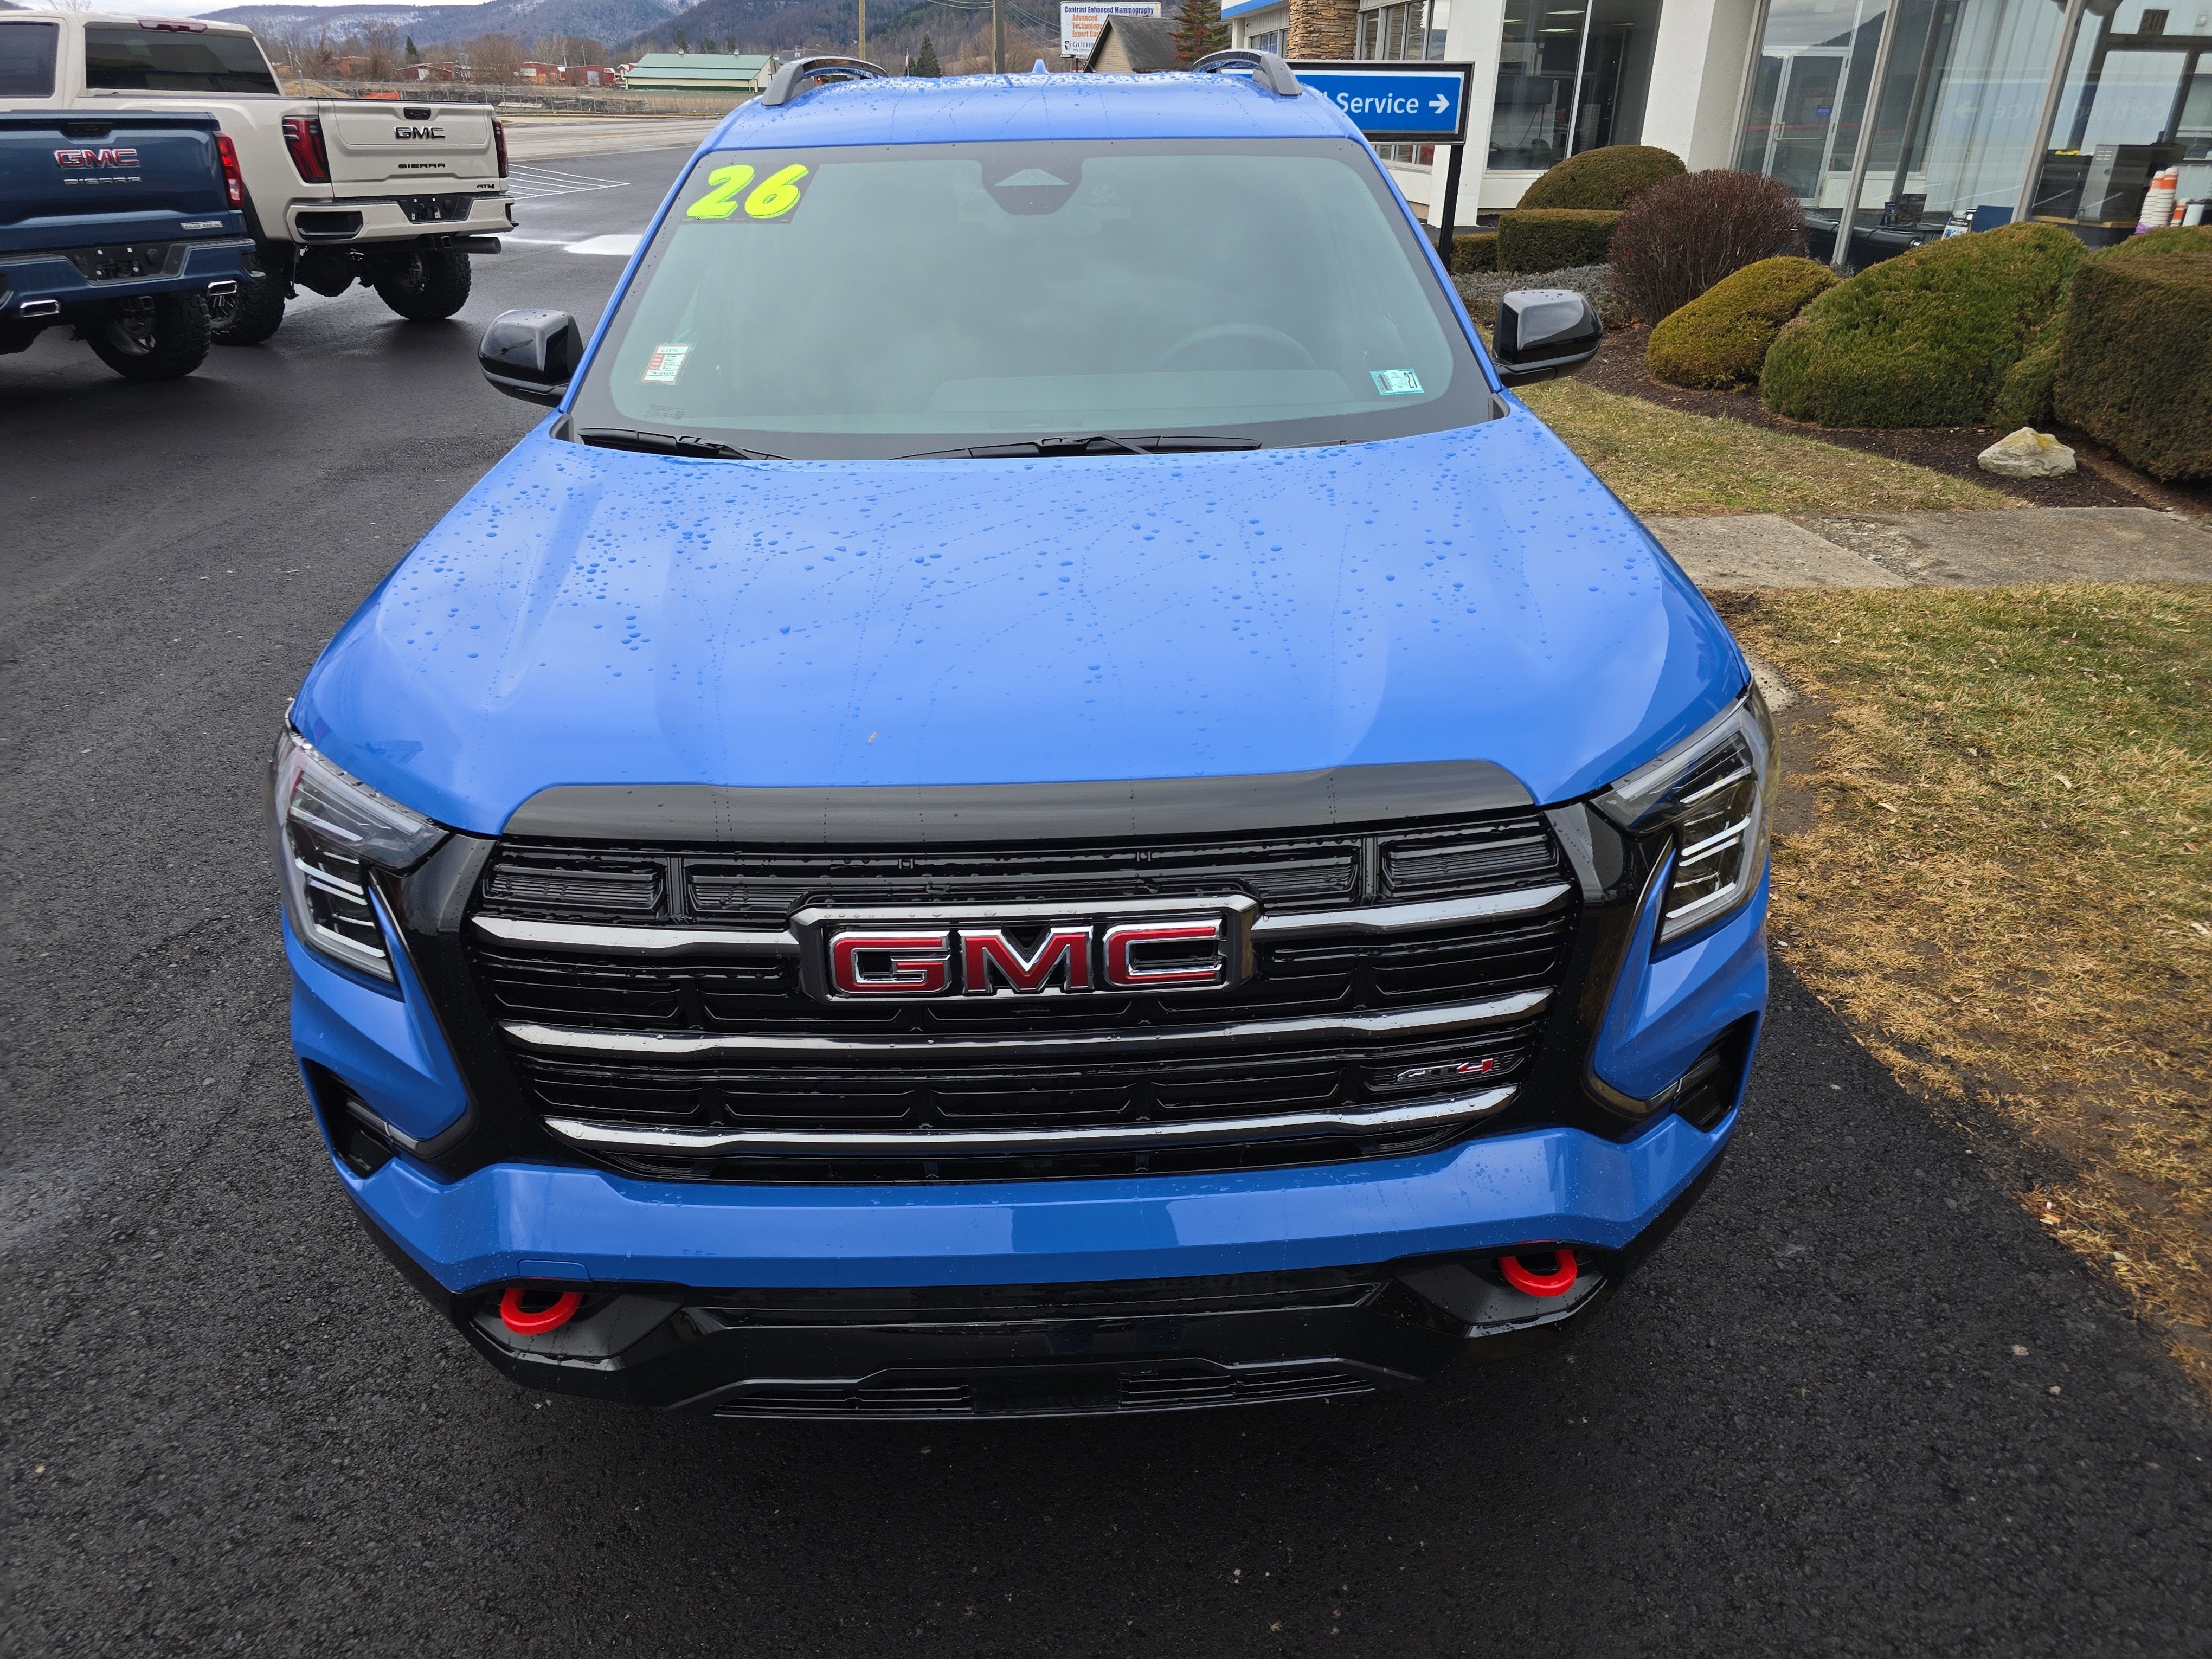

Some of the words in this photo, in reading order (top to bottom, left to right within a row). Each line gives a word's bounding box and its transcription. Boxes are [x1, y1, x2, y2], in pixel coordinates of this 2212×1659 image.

[1115, 7, 1154, 15] Mammography
[1336, 92, 1419, 114] Service
[394, 126, 446, 140] GMC
[55, 148, 140, 169] GMC
[63, 177, 142, 185] SIERRA
[686, 164, 809, 219] 26
[1403, 372, 1418, 389] 27
[829, 919, 1224, 995] GMC
[1397, 1058, 1494, 1082] AT4
